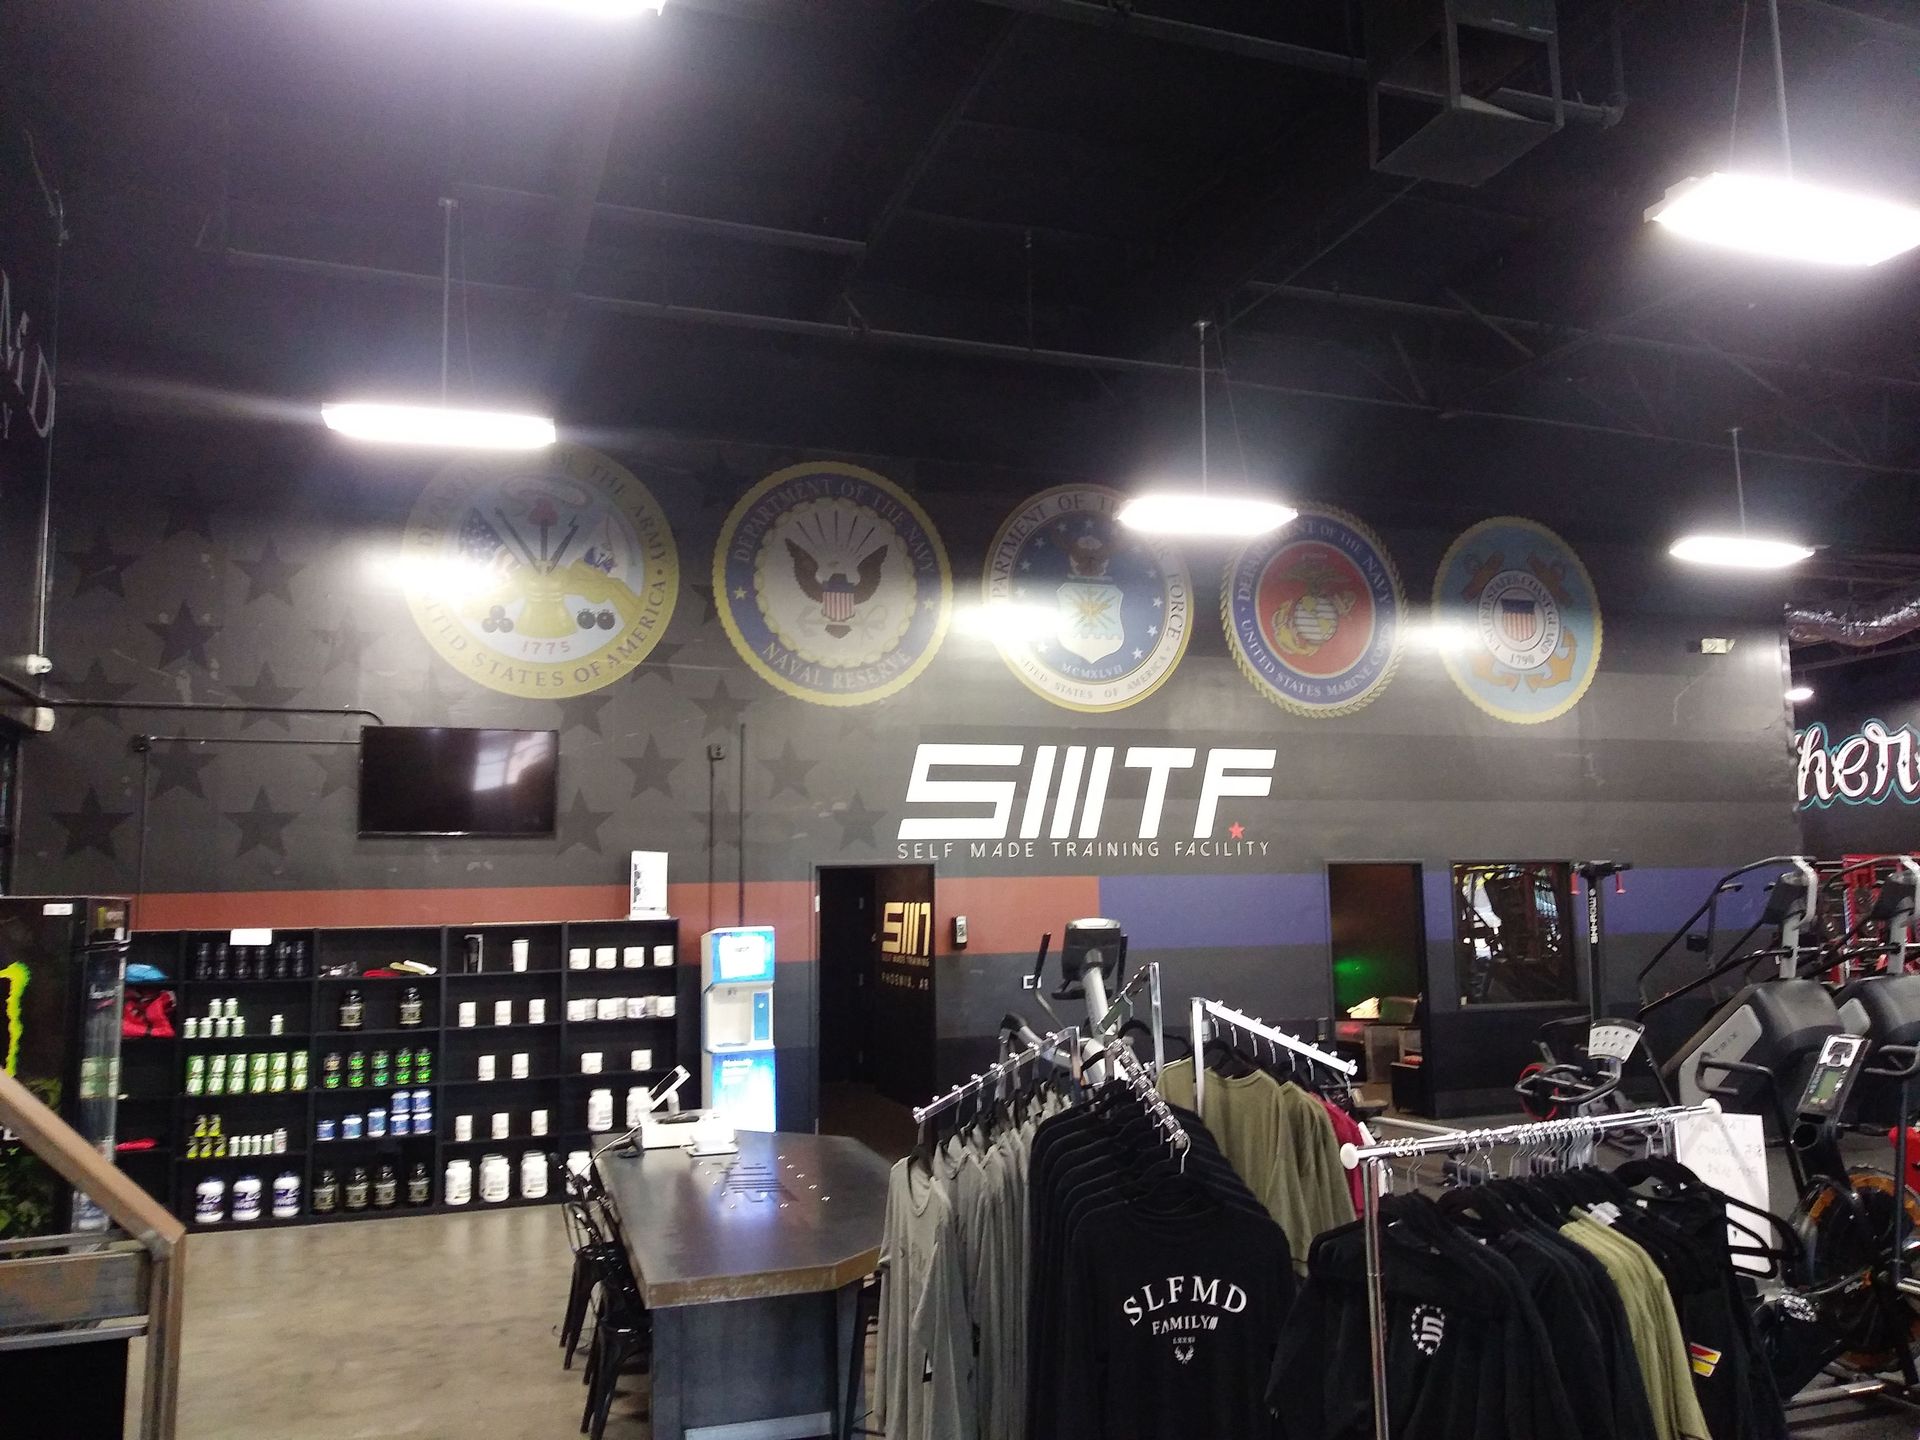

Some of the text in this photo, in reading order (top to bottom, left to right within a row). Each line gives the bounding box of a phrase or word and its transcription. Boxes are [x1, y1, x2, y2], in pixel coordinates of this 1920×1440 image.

[733, 478, 935, 572] DEPARTMENT OF THE NAVY
[1057, 495, 1084, 511] OF
[632, 505, 667, 563] ARMY
[1339, 529, 1362, 553] THE
[1363, 556, 1392, 607] NAVY
[471, 652, 565, 688] STATES
[573, 659, 600, 684] OF
[606, 578, 668, 670] AMERICA
[1168, 572, 1187, 641] FORCE
[521, 640, 572, 656] 1775
[763, 641, 912, 689] NAVAL RESERVE
[1242, 619, 1276, 674] UNITED
[1276, 670, 1323, 698] STATES
[1327, 664, 1373, 697] MARINE
[1055, 681, 1094, 700] STATES
[1103, 689, 1119, 699] OF
[1126, 655, 1167, 692] AMERICA
[896, 840, 1271, 860] SELF MADE TRAINING FACILITY
[1122, 1275, 1248, 1328] SLFMD
